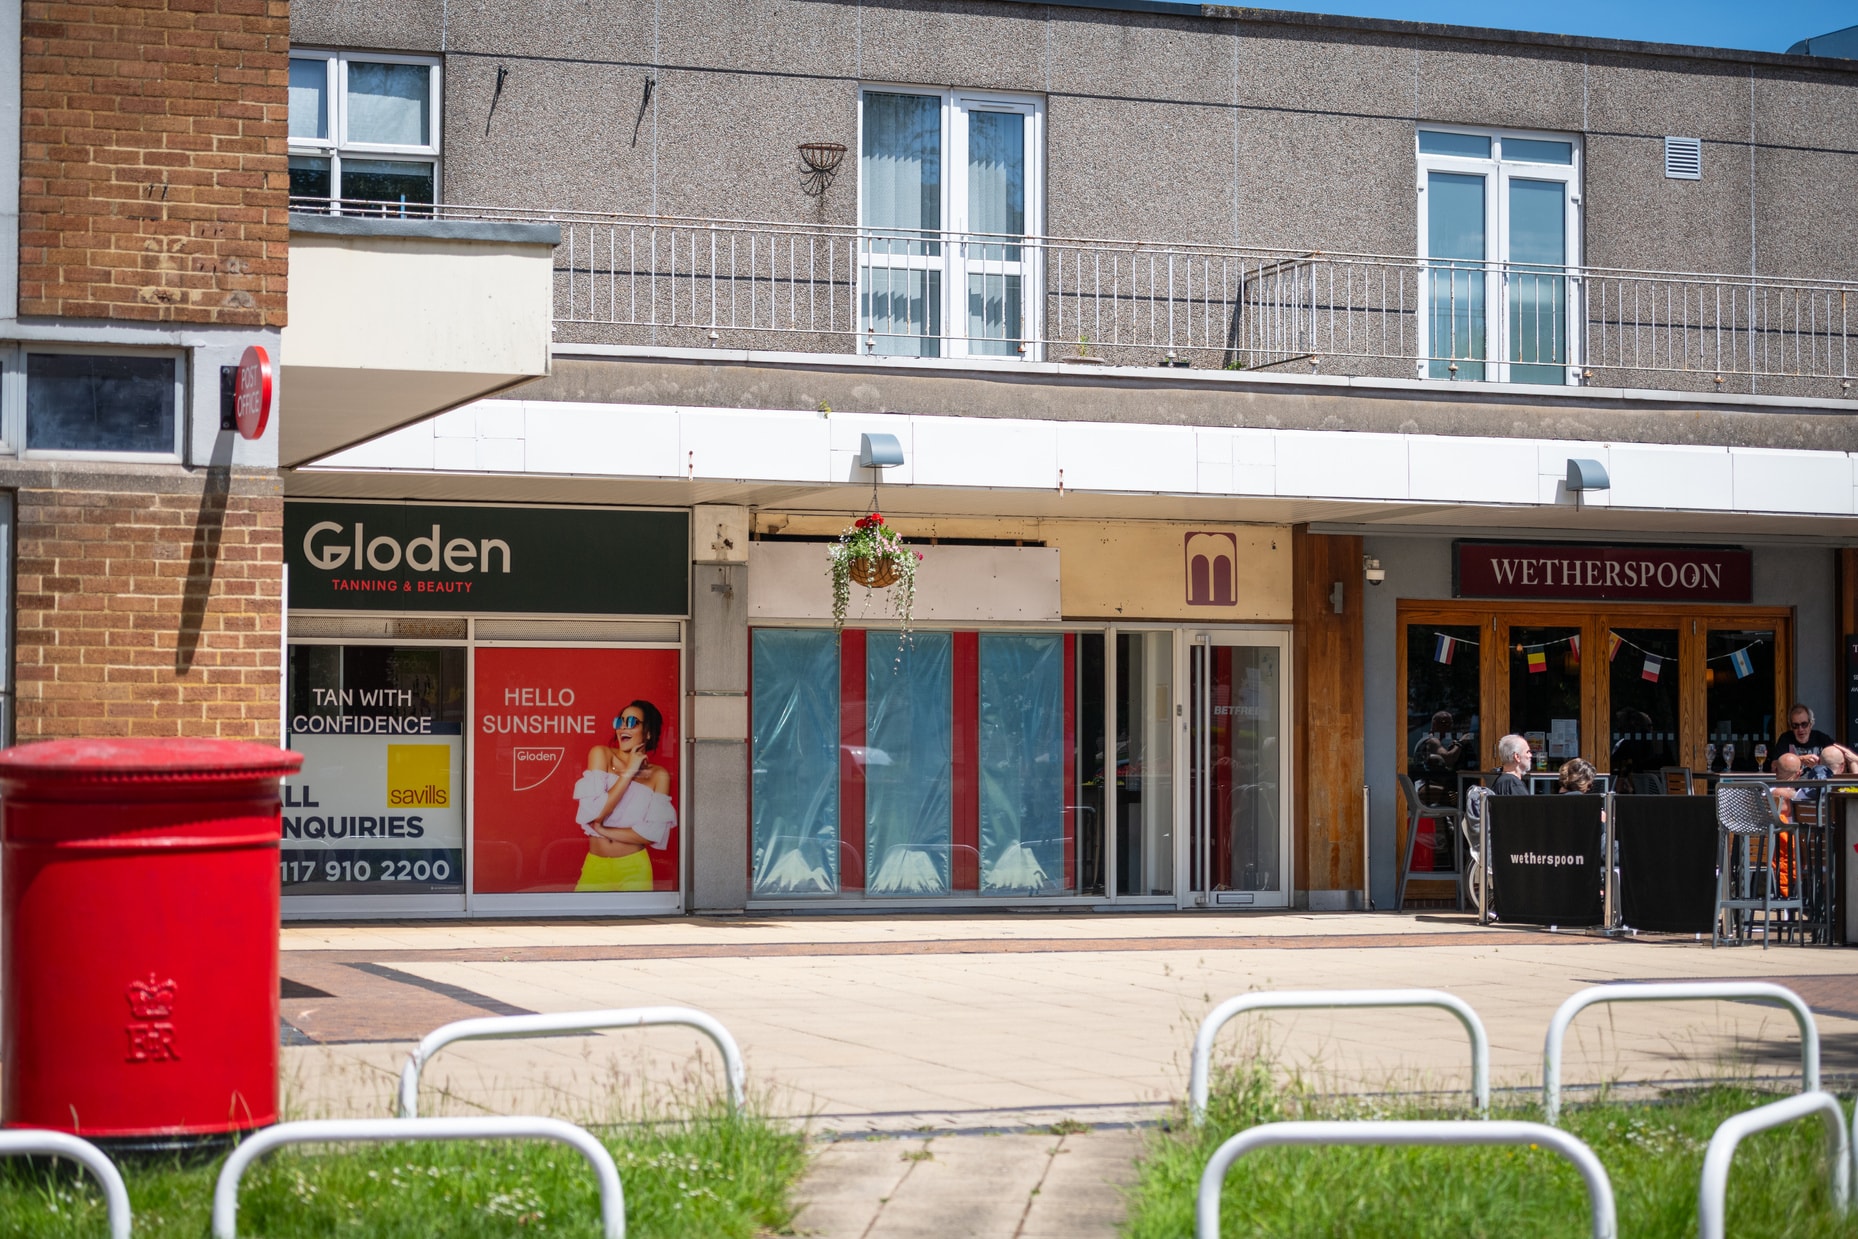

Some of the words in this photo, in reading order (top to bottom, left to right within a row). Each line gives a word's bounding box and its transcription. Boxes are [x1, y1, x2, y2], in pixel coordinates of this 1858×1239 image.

[241, 365, 258, 390] POST
[237, 391, 259, 417] OFFICE
[303, 520, 511, 574] Gloden
[1490, 558, 1722, 589] WETHERSPOON
[332, 579, 398, 592] TANNING
[403, 581, 412, 592] &
[417, 581, 473, 593] BEAUTY
[312, 688, 354, 707] TAN
[359, 688, 412, 707] WITH
[504, 688, 575, 707] HELLO
[292, 715, 432, 734] CONFIDENCE
[482, 715, 596, 734] SUNSHINE
[517, 751, 557, 761] Gloden
[280, 785, 320, 808] LL
[390, 785, 447, 805] savills
[281, 816, 424, 839] NQUIRIES
[1510, 852, 1585, 868] wetherspoon
[280, 861, 316, 882] 117
[325, 860, 371, 882] 910
[380, 860, 450, 881] 2200
